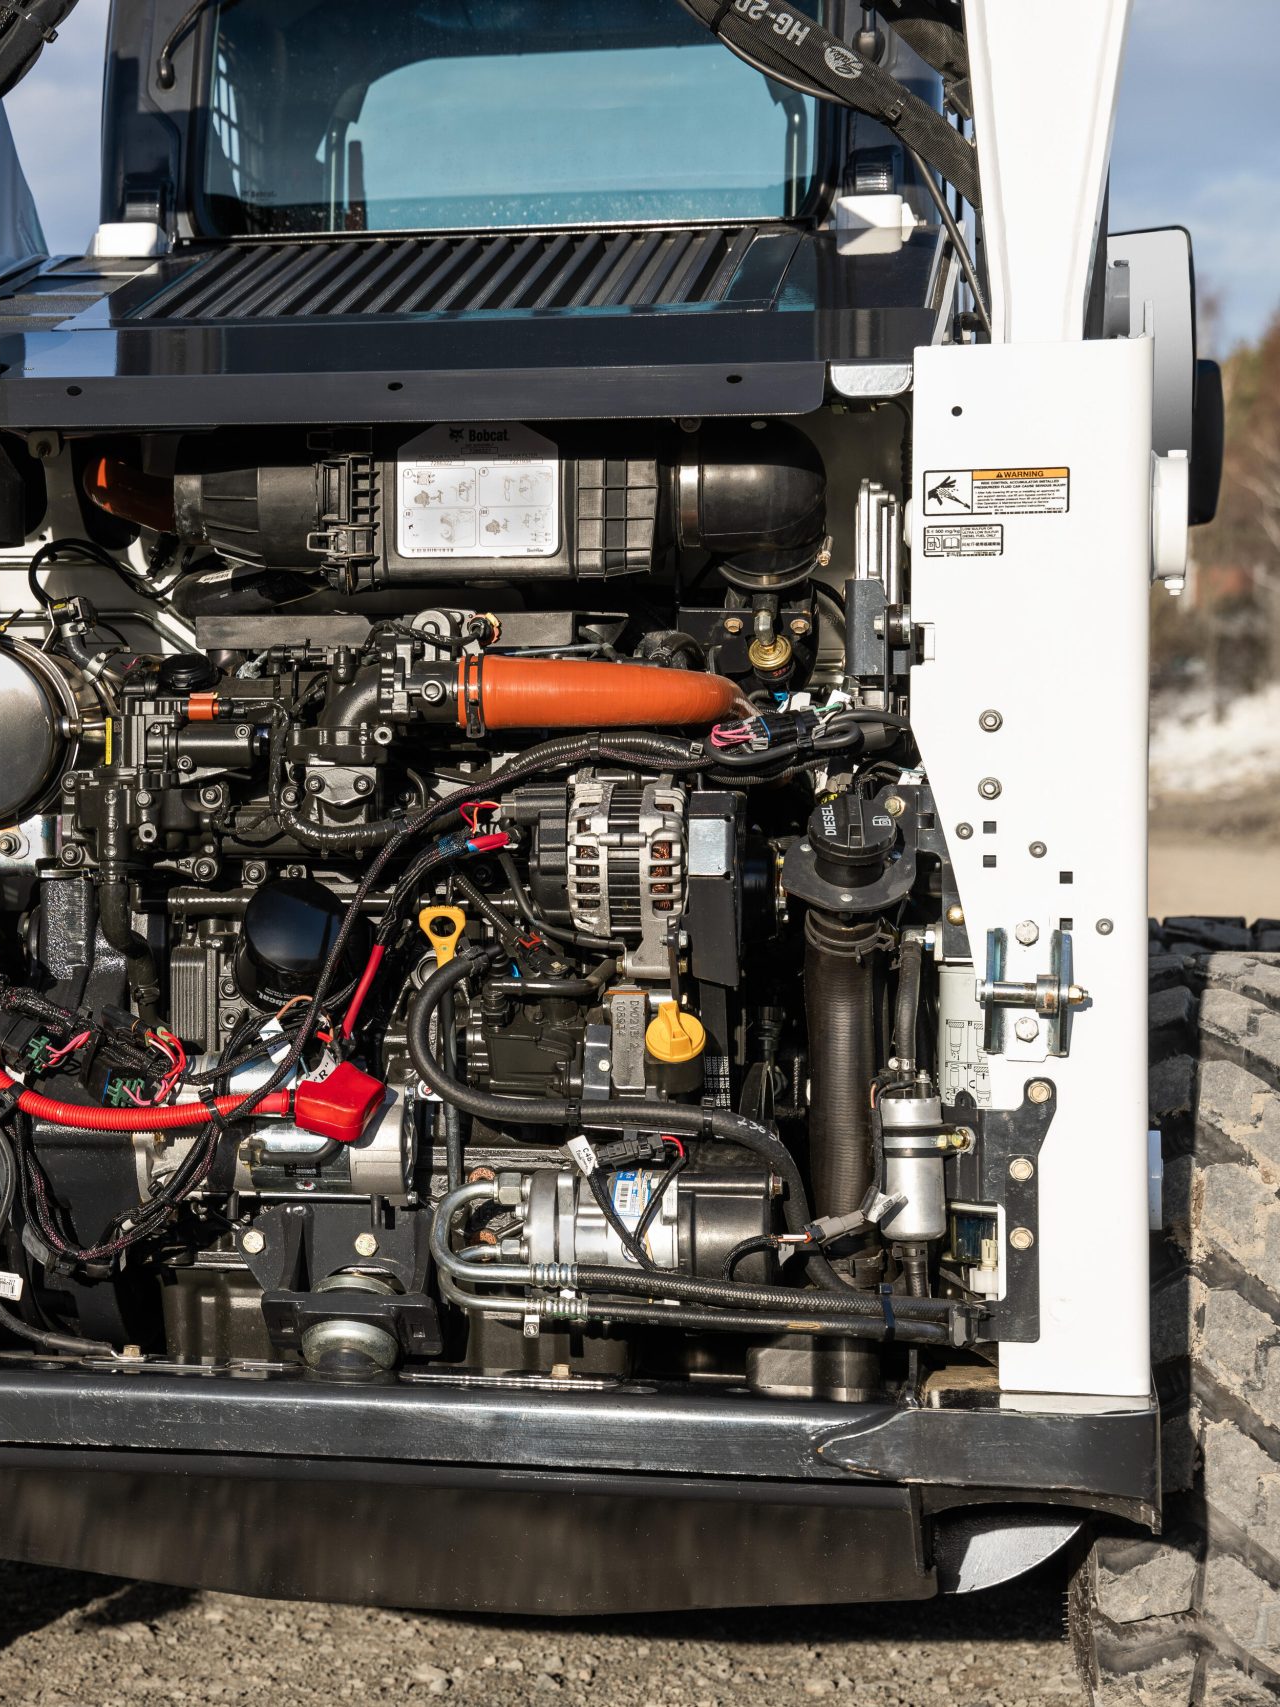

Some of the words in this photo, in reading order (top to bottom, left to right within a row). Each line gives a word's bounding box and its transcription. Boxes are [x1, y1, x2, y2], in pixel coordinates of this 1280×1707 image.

[468, 429, 508, 442] Bobcat
[1003, 470, 1044, 478] WARNING
[821, 804, 837, 836] DIESEL
